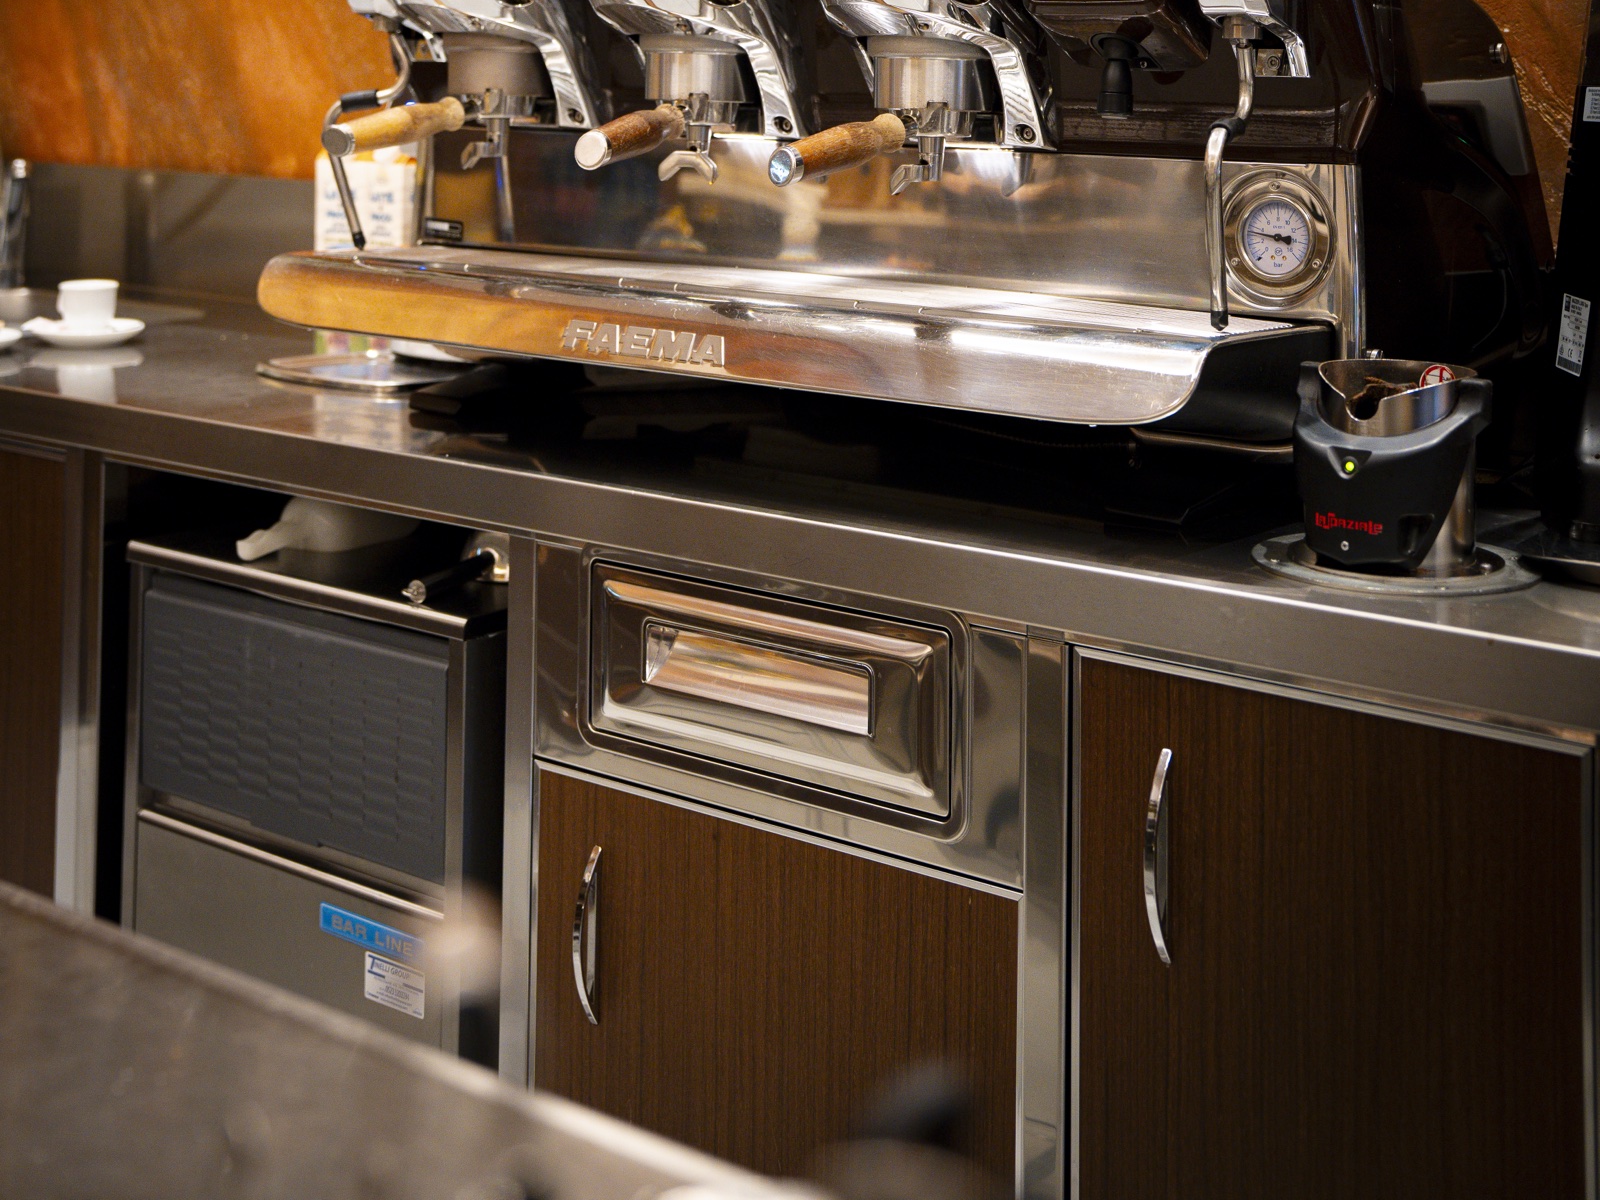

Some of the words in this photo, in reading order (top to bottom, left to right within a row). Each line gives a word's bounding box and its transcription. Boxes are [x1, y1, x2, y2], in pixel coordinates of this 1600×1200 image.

[561, 319, 725, 368] FAEMA
[331, 914, 368, 940] BAR
[374, 931, 414, 958] LINE
